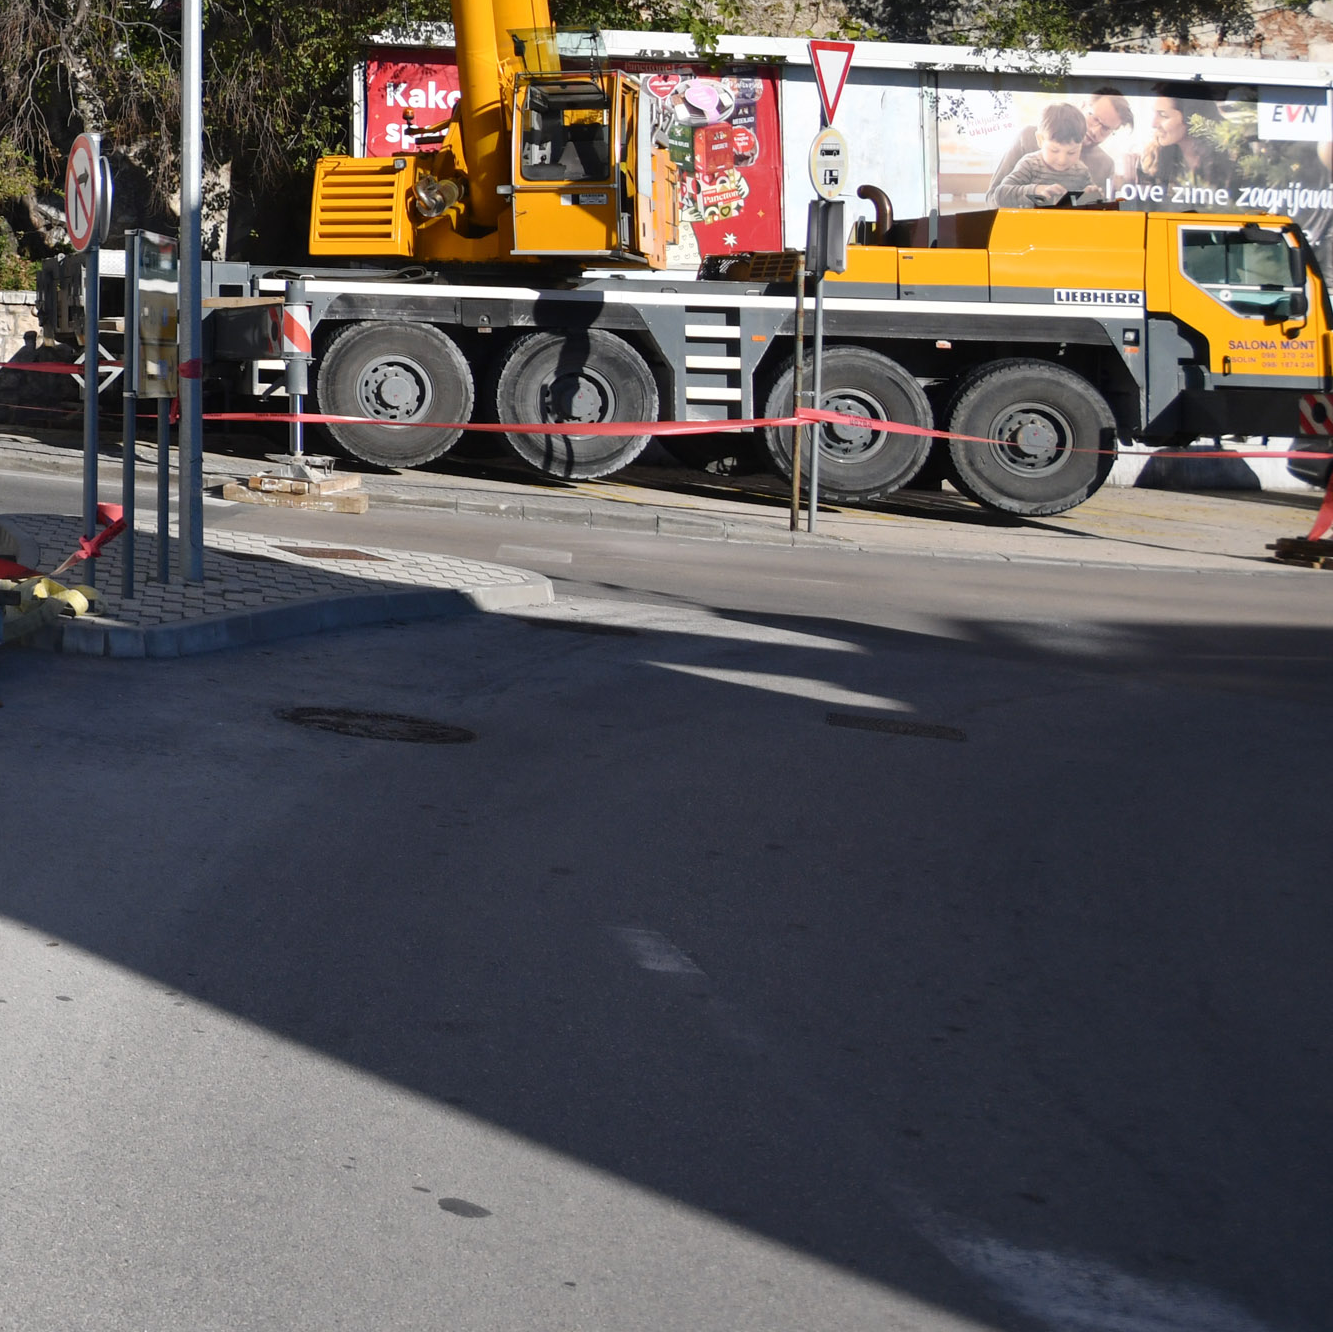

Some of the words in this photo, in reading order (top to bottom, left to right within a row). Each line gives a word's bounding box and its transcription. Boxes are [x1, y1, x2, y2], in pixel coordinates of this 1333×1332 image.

[1272, 105, 1317, 123] EVN
[704, 190, 739, 203] Panetton
[1171, 181, 1229, 206] zime
[1056, 291, 1140, 304] LIEBHERR
[1228, 340, 1277, 350] SALONA
[1280, 340, 1315, 350] MONT
